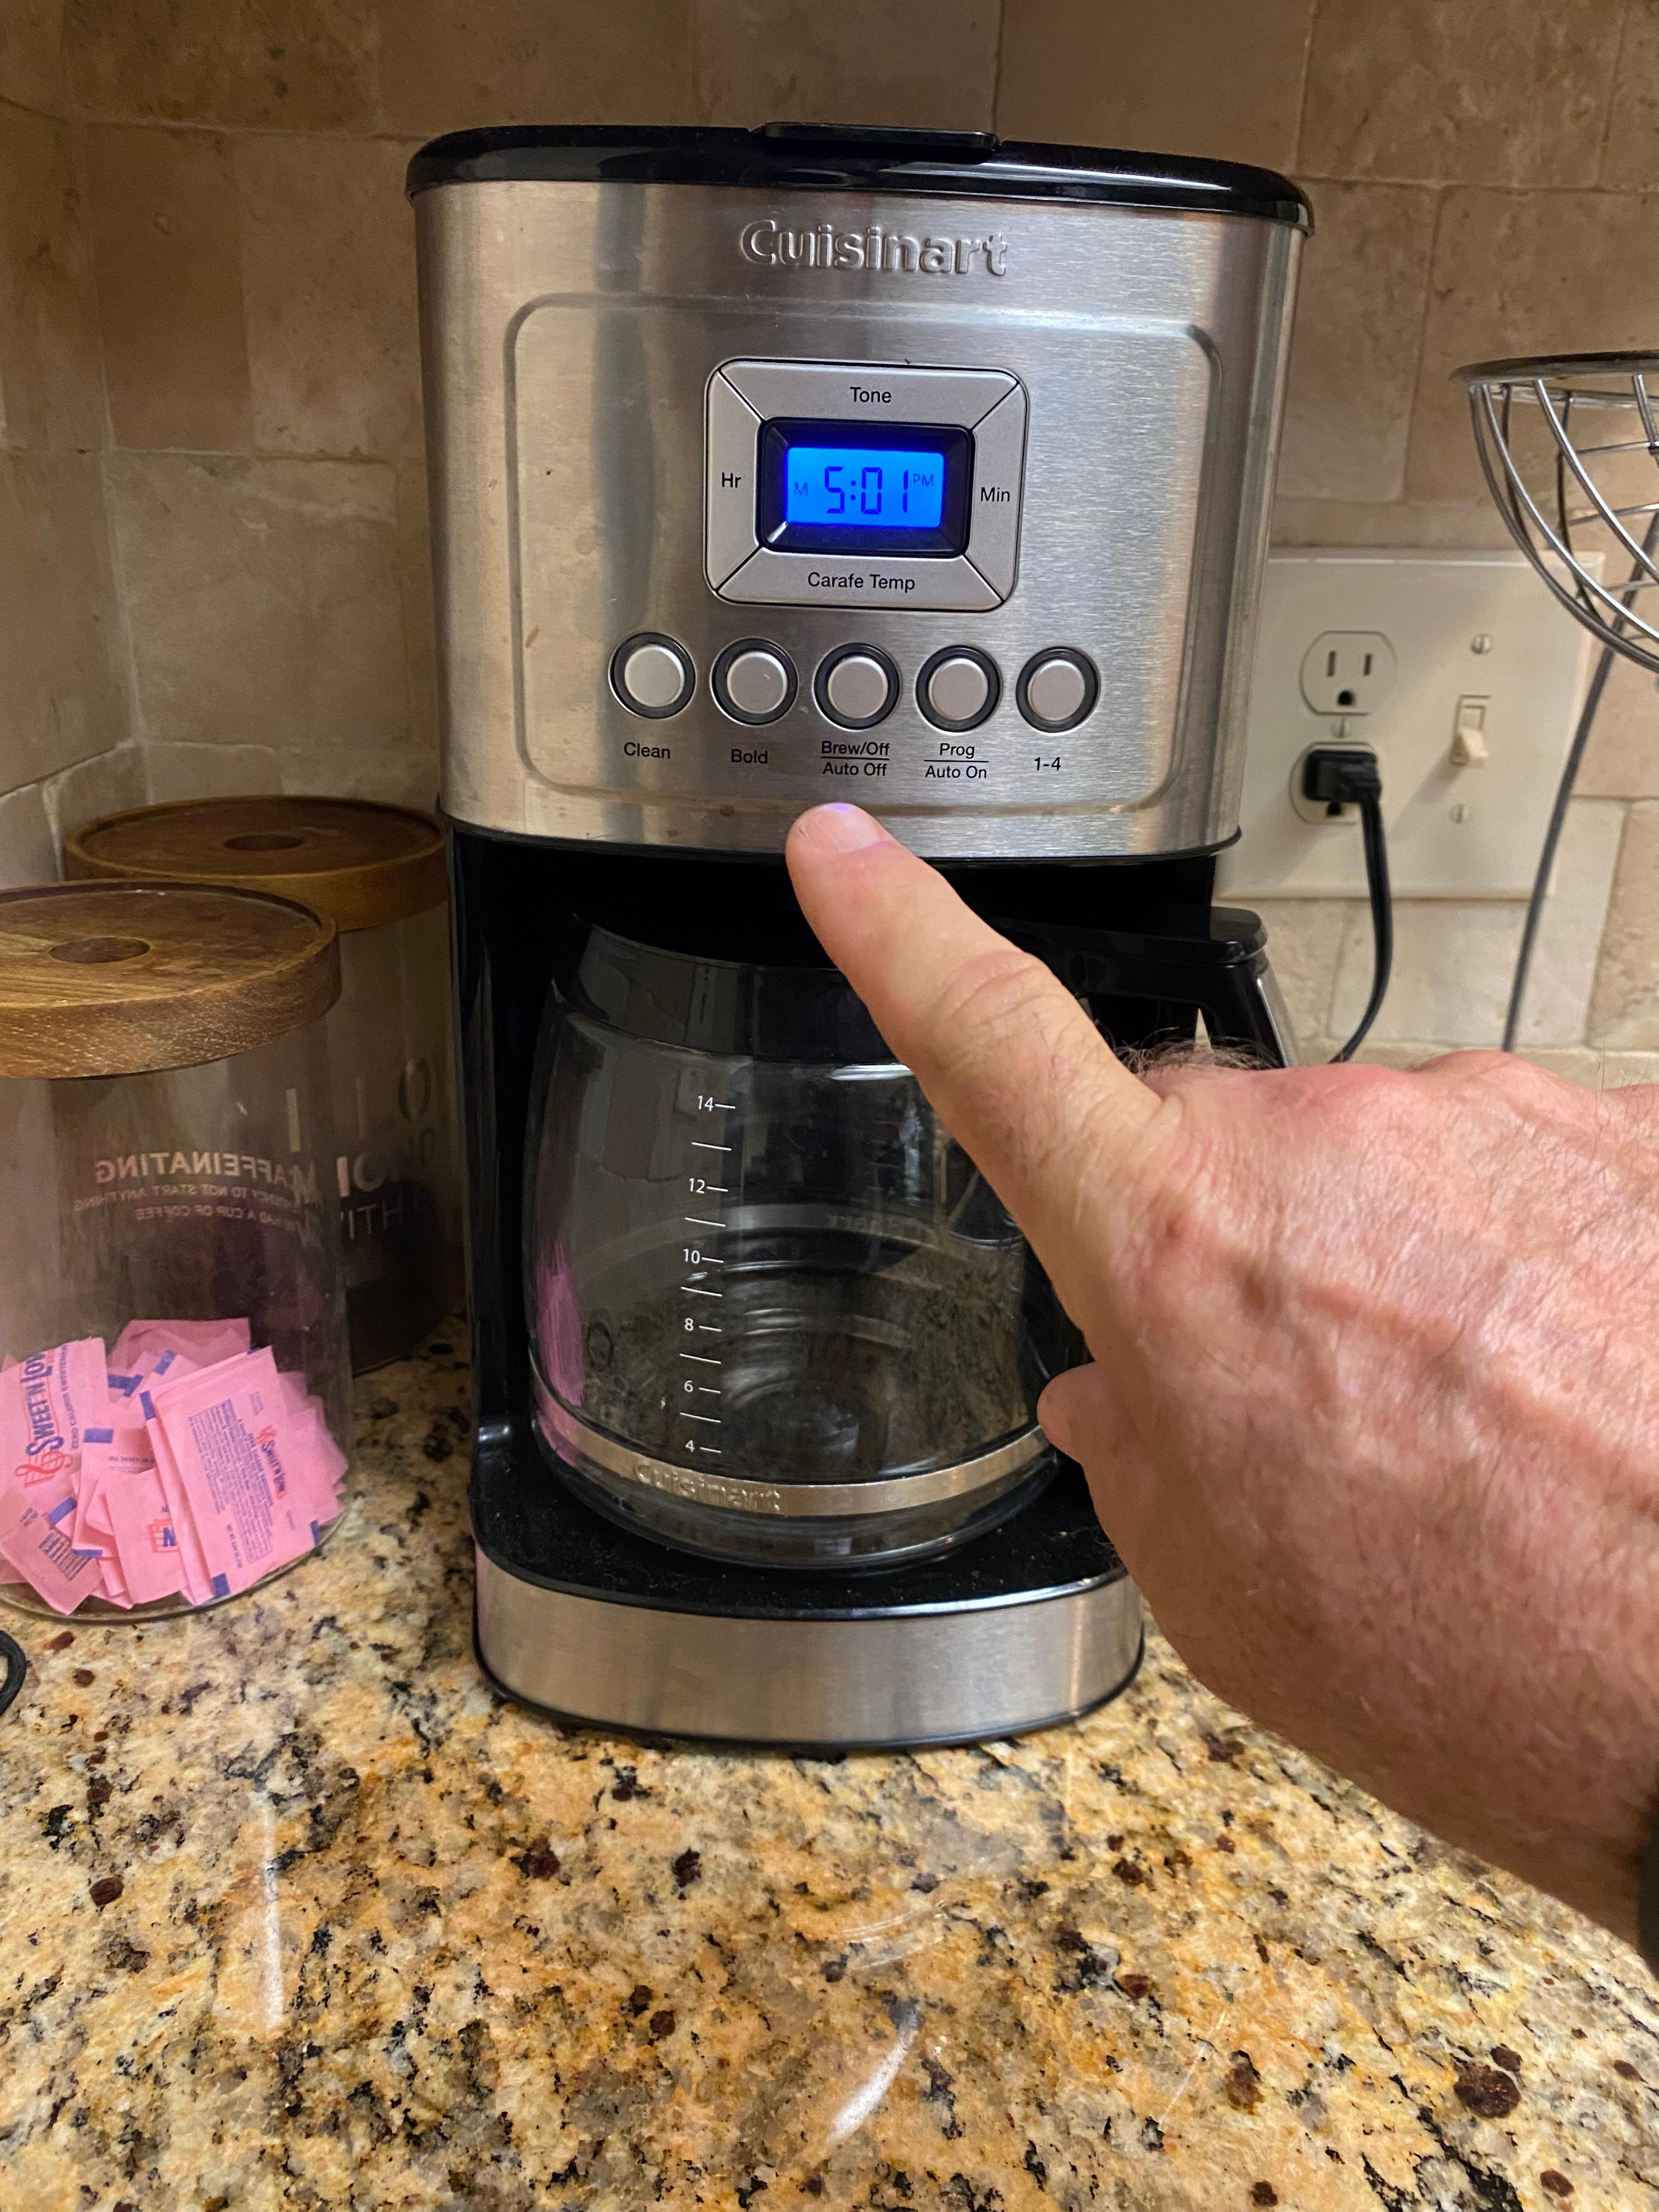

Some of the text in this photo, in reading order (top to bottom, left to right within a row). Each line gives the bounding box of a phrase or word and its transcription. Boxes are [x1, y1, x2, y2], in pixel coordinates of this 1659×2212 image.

[739, 218, 1008, 276] Cuisinart
[850, 386, 892, 404] Tone
[721, 472, 741, 488] Hr
[912, 473, 934, 487] PM
[825, 466, 909, 515] 5:01
[980, 487, 1011, 503] Min
[808, 571, 915, 592] Carafe Temp
[623, 742, 670, 759] Clean
[821, 741, 890, 755] Brew/Off
[940, 742, 975, 759] Prog
[731, 748, 768, 765] Bold
[1034, 757, 1062, 771] 1-4
[823, 761, 887, 777] Auto Off
[925, 765, 987, 779] Auto On
[697, 1096, 714, 1111] 14
[689, 1178, 706, 1194] 12
[683, 1249, 700, 1263] 10
[684, 1318, 694, 1332] 8
[684, 1380, 693, 1393] 6
[685, 1440, 695, 1452] 4
